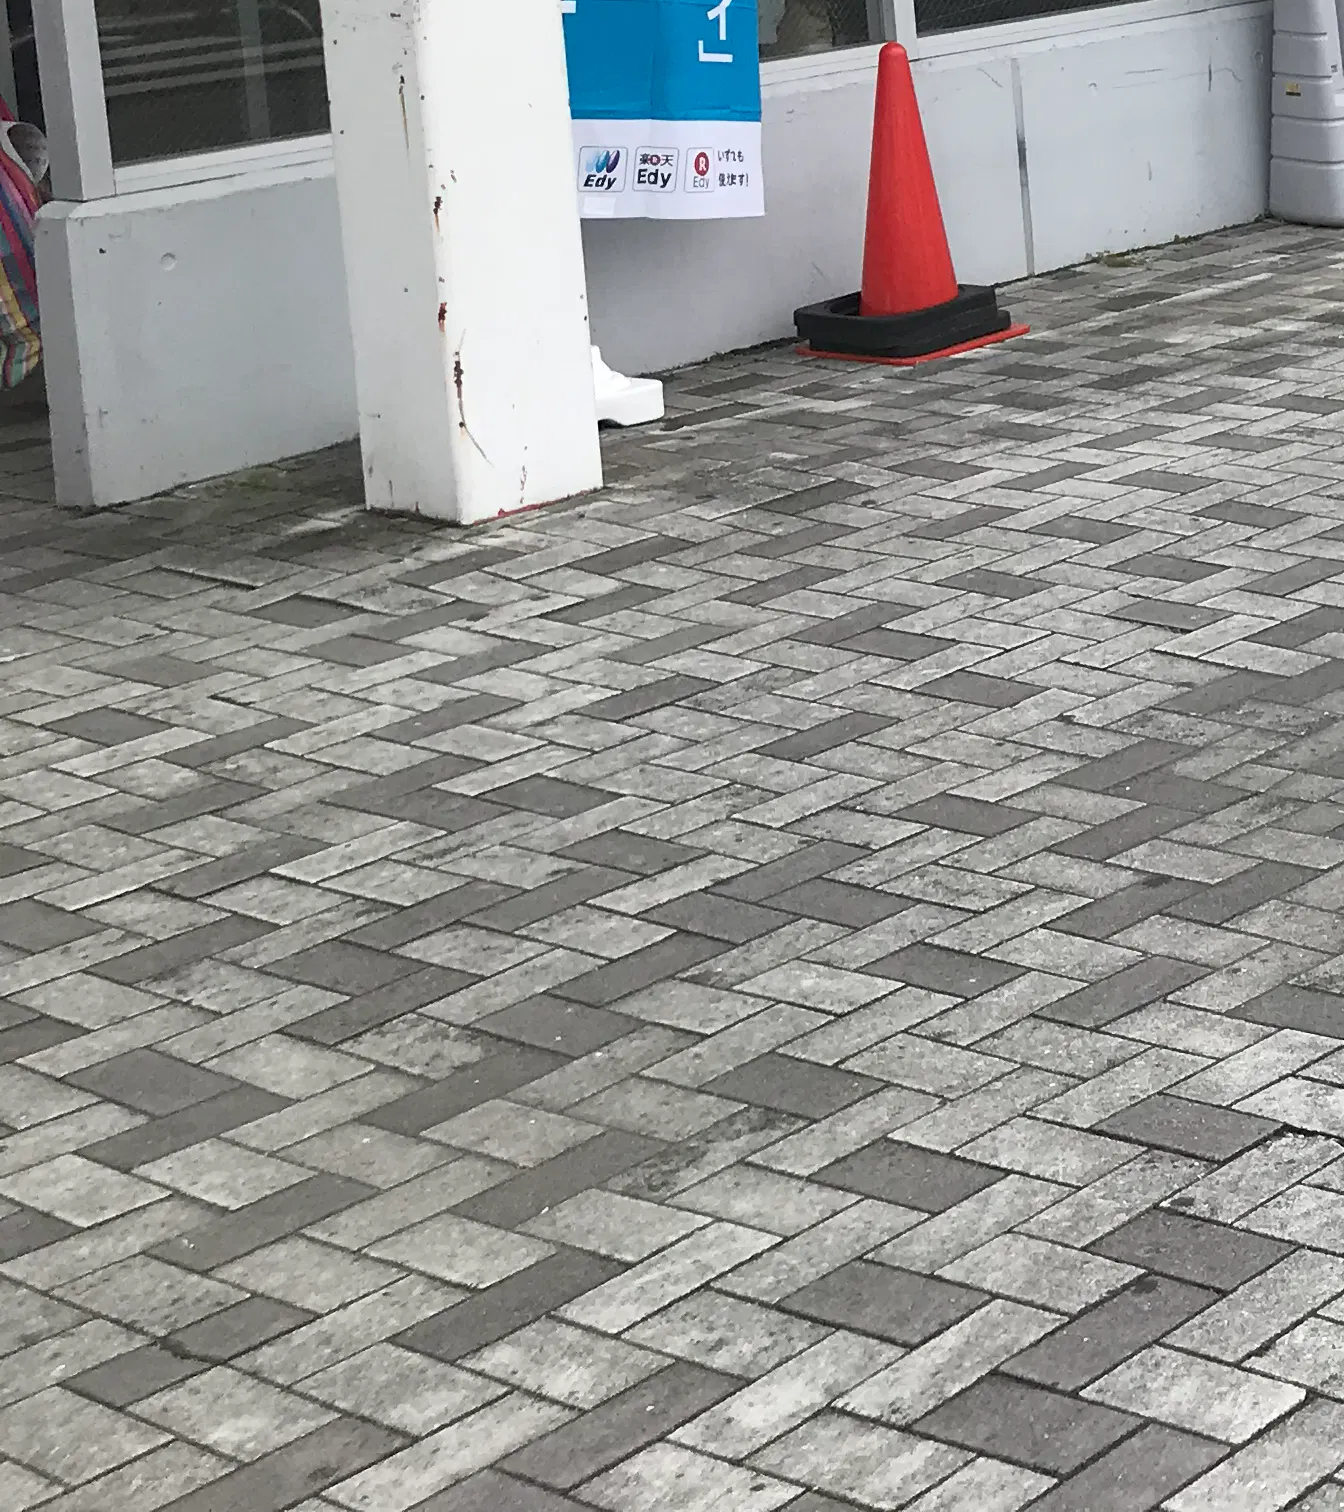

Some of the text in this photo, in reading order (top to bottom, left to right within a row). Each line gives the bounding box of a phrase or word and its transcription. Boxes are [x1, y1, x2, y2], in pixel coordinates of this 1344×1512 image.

[583, 174, 617, 190] Edy
[637, 168, 672, 189] Edy
[692, 175, 710, 190] Edy
